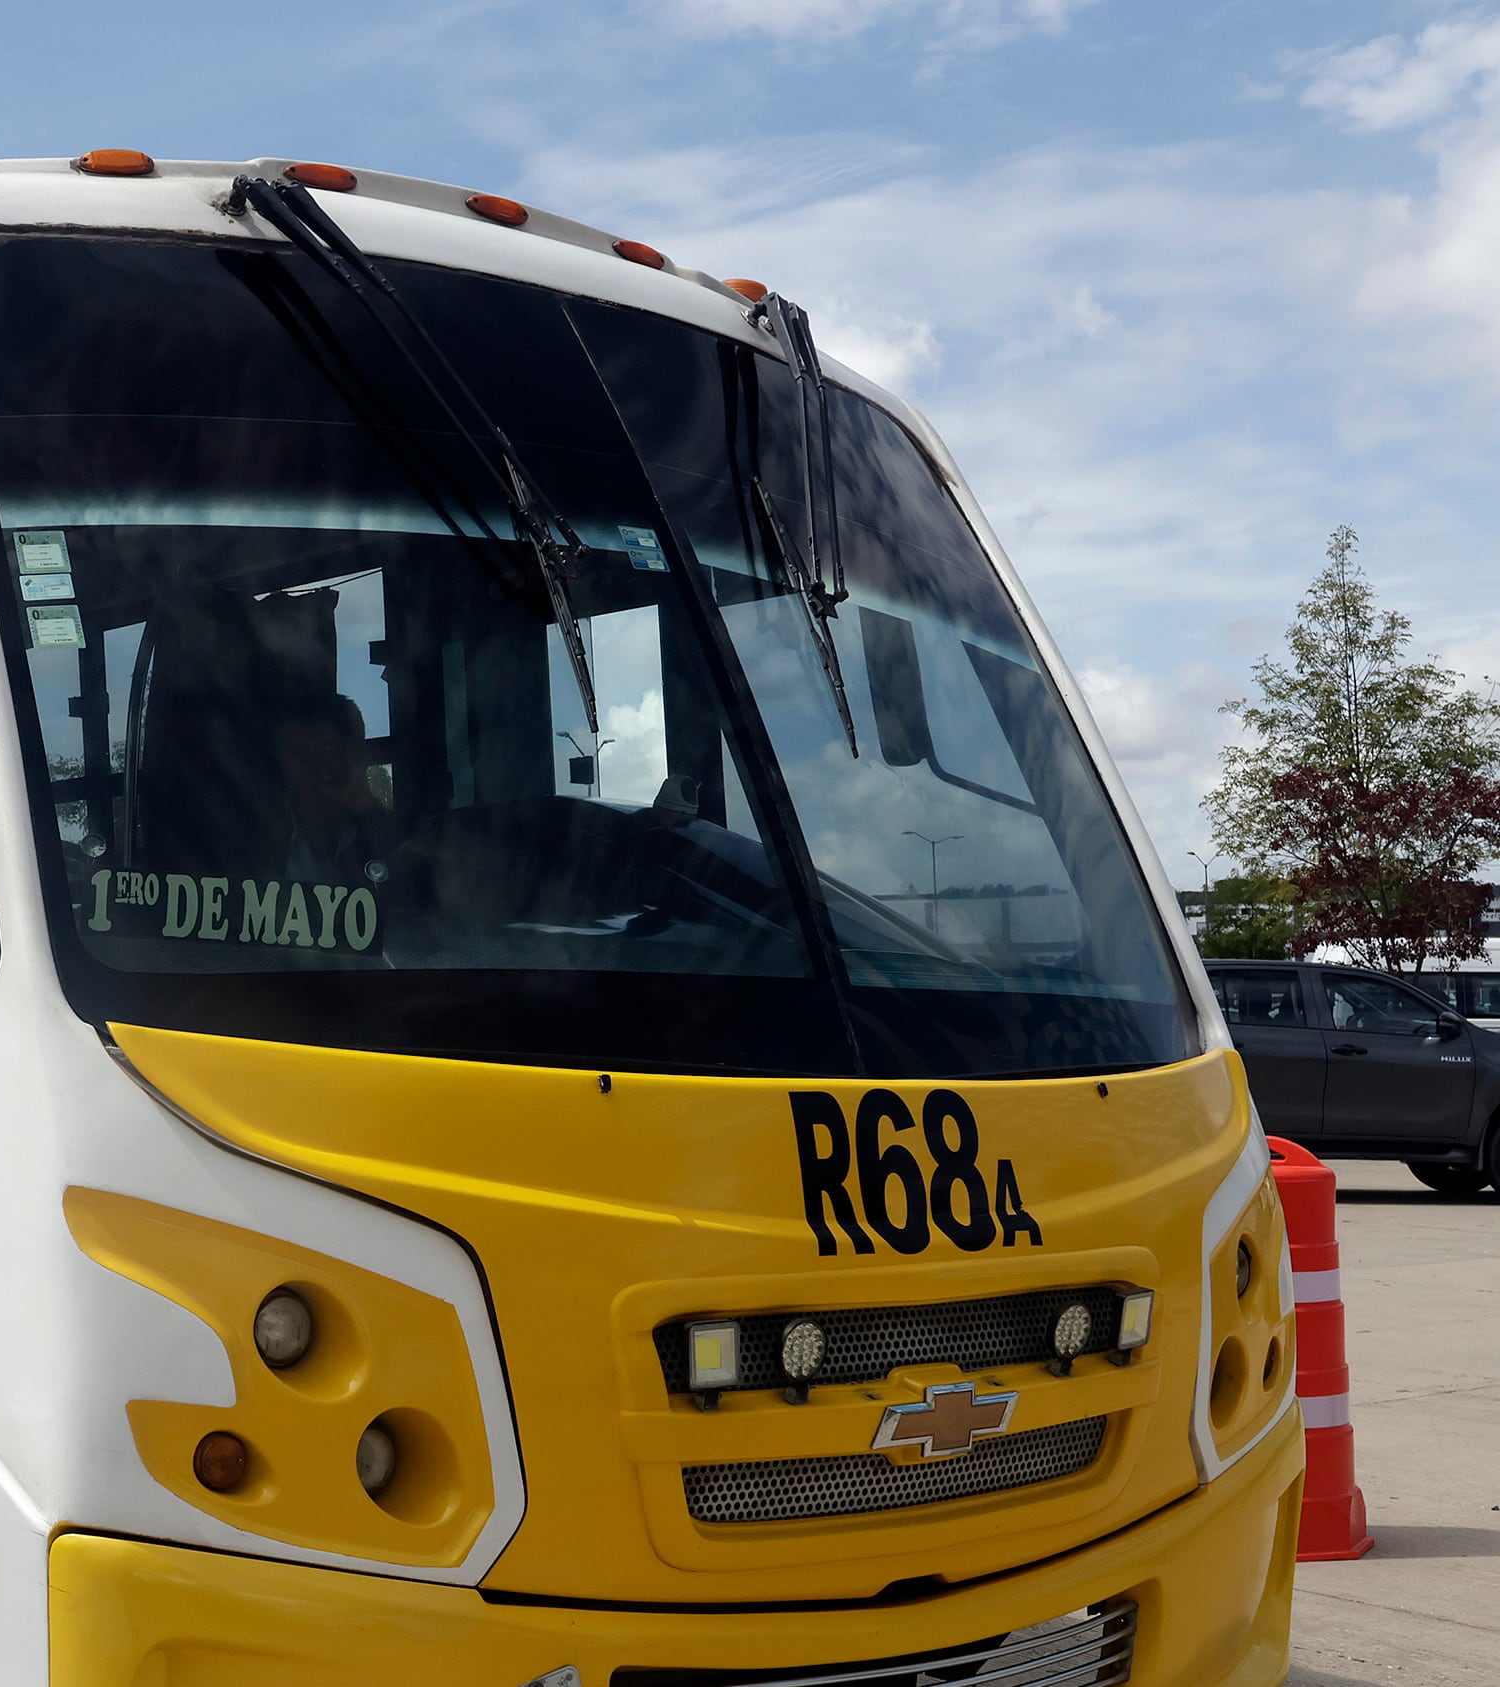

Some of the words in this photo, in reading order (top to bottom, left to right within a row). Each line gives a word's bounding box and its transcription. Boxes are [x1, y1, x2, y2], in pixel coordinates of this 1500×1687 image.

[162, 873, 229, 941] DE
[239, 878, 377, 951] MAYO
[788, 1088, 1043, 1256] R68A
